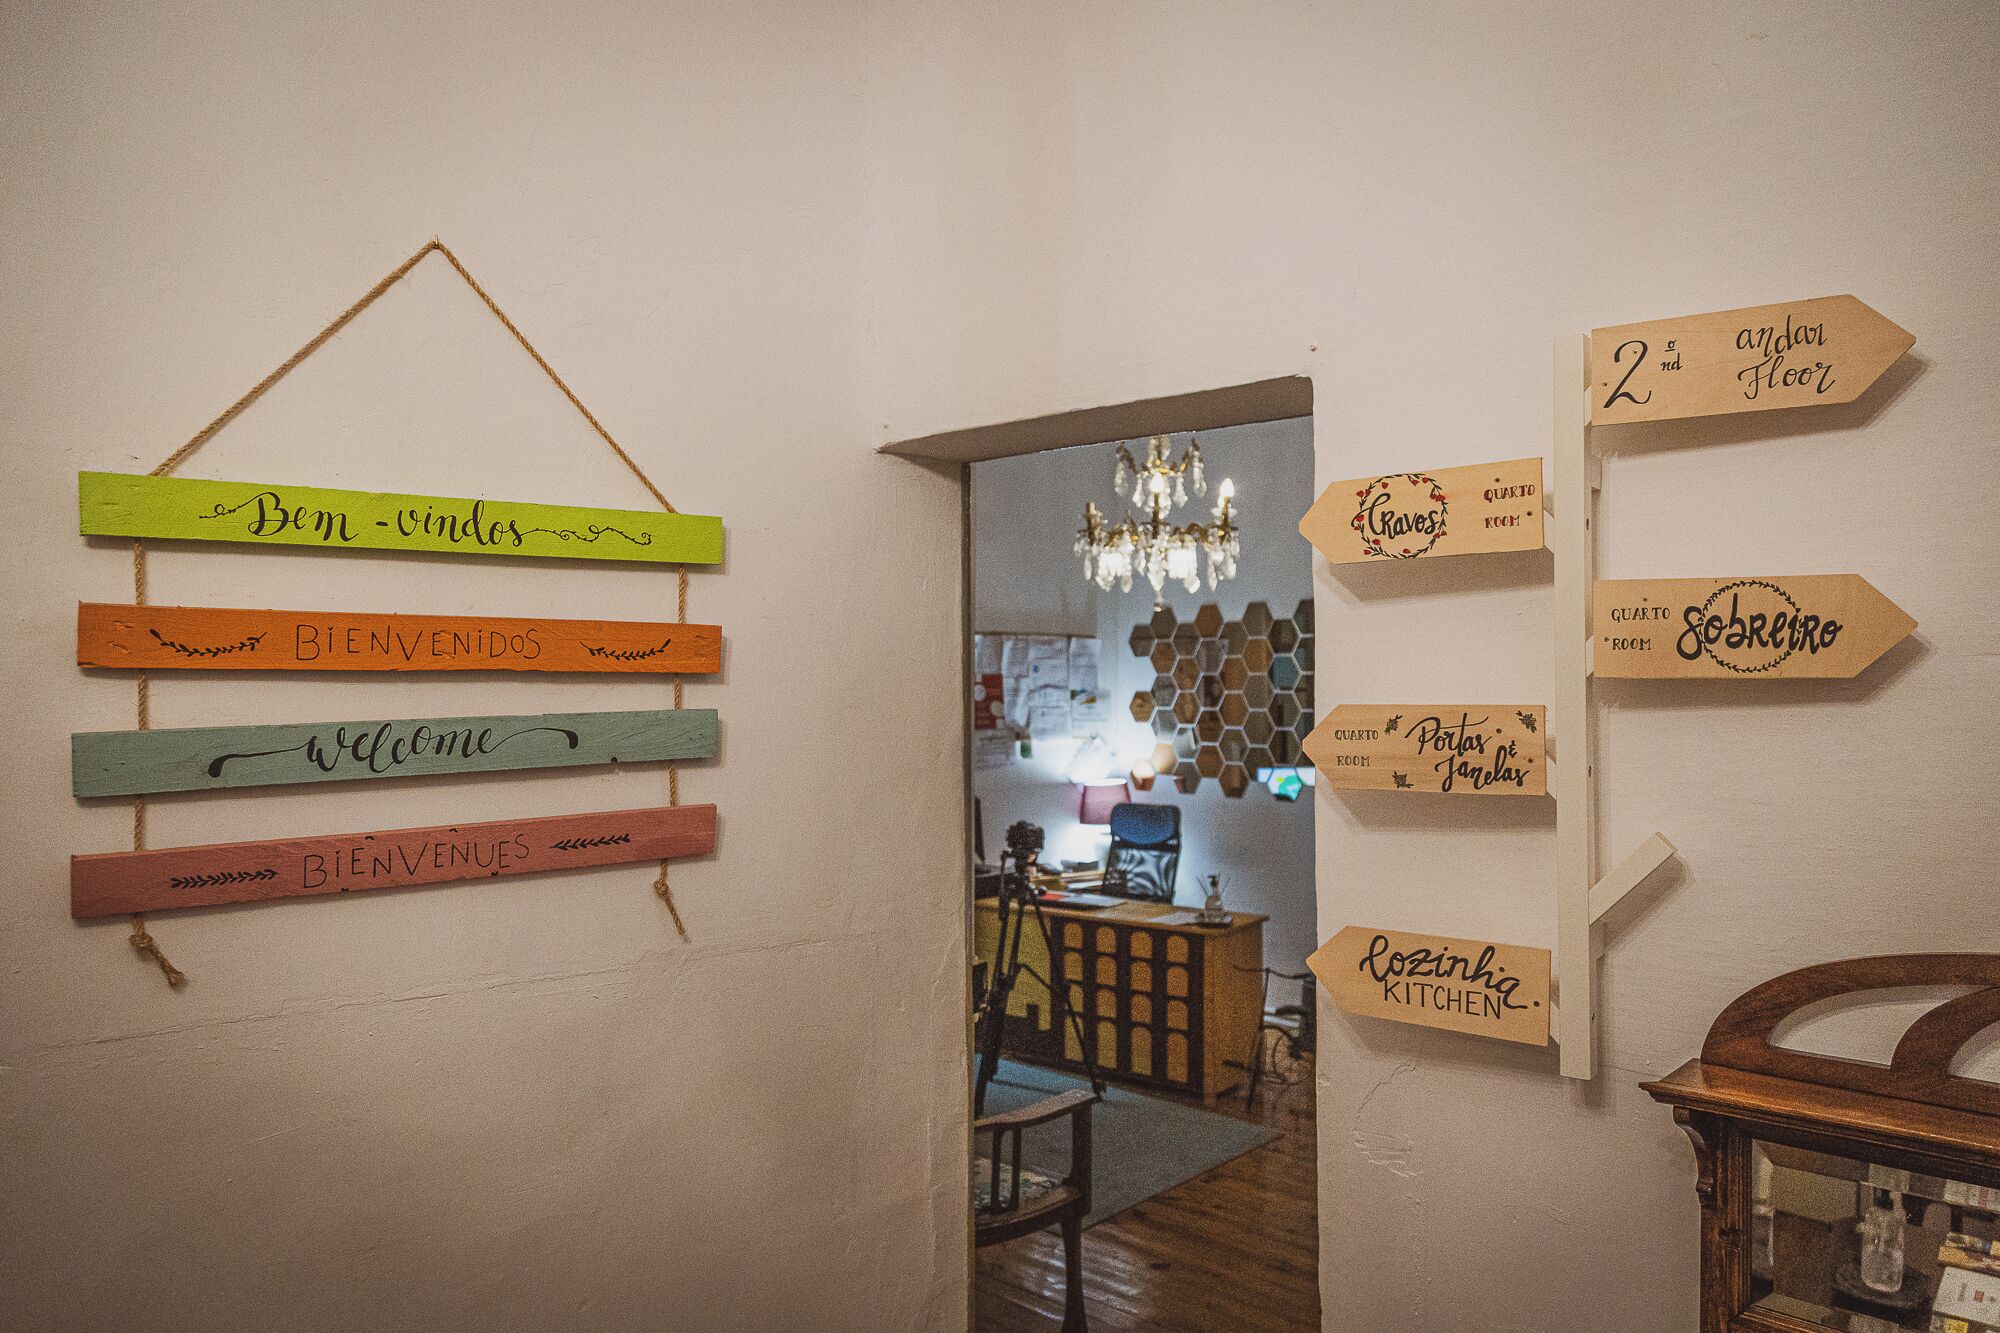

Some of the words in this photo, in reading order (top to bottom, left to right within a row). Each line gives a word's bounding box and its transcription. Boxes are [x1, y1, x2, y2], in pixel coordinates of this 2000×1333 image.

[1736, 314, 1828, 357] andar
[1661, 353, 1683, 371] nd
[1603, 340, 1652, 408] 2
[1737, 356, 1836, 400] Floor
[1483, 484, 1536, 503] QUARTO
[1484, 514, 1521, 529] ROOM
[1611, 606, 1671, 622] QUARTO
[1612, 637, 1651, 651] ROOM
[1334, 729, 1380, 741] QUARTO
[1404, 713, 1493, 757] Portas
[1336, 755, 1371, 767] ROOM
[1434, 745, 1530, 793] Janelas
[1384, 979, 1501, 1020] KITCHEN
